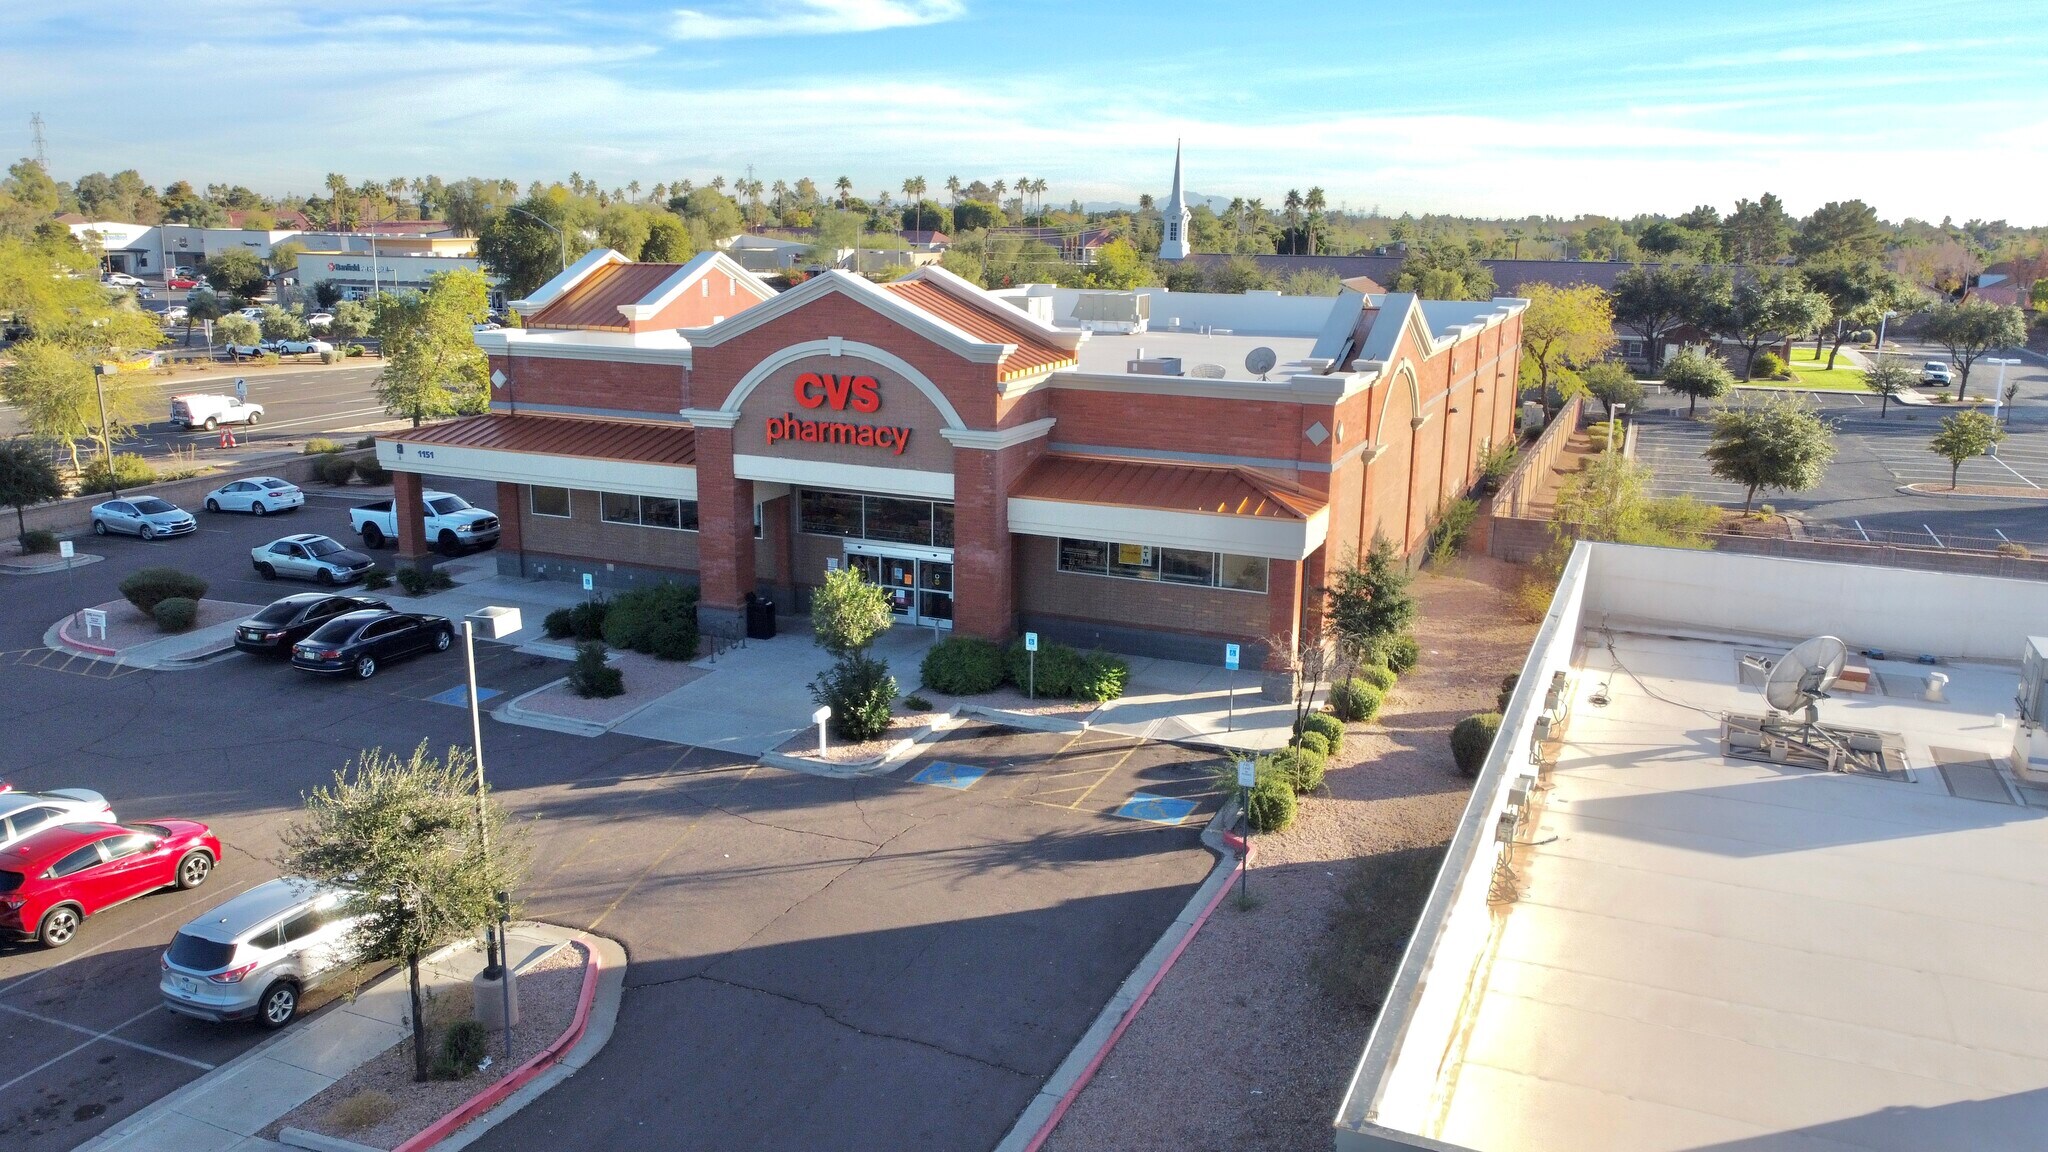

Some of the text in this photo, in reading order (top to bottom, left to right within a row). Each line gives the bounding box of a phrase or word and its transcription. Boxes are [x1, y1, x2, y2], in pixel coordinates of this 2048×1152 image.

[794, 372, 881, 413] CVS
[766, 412, 911, 455] pharmacy
[417, 450, 434, 459] 1151
